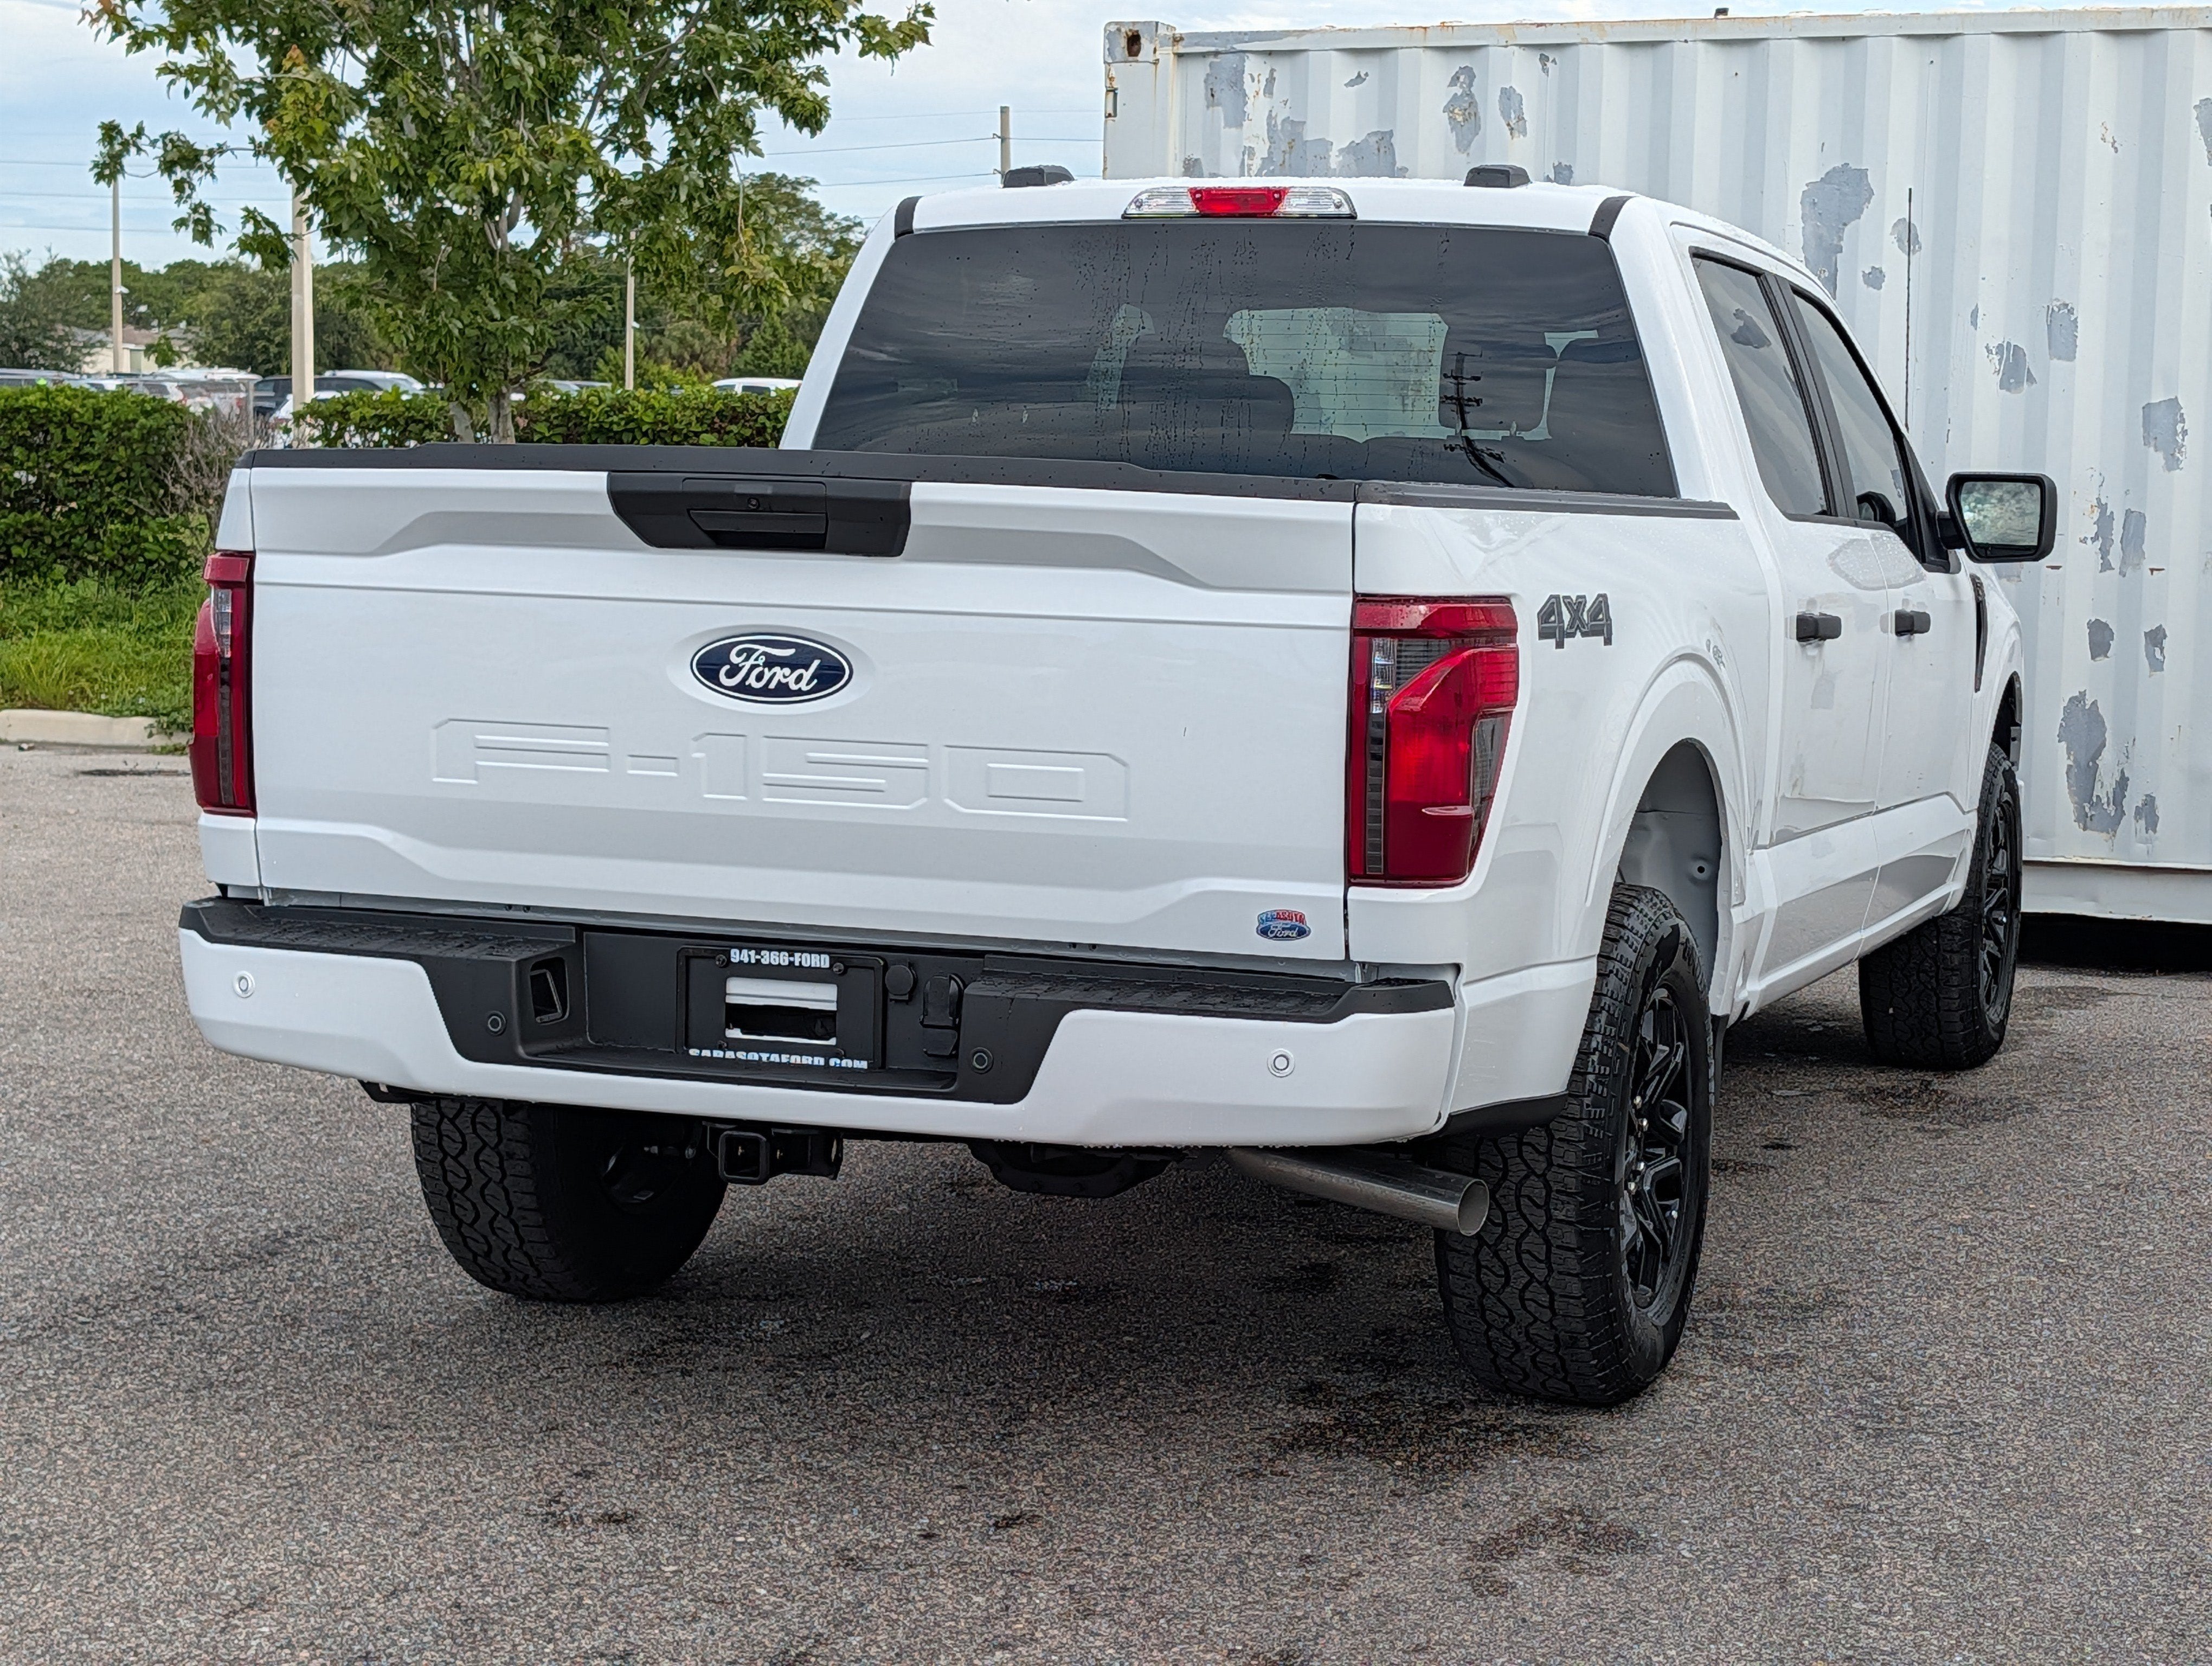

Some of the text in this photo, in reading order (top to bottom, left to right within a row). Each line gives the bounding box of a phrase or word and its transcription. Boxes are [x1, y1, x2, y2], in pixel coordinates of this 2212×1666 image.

[1536, 593, 1613, 650] 4X4
[719, 643, 821, 691] Ford
[432, 718, 1129, 822] F-150
[1268, 922, 1299, 938] Ford
[730, 949, 830, 969] 941-366-FORD
[688, 1048, 868, 1069] SARASOTAFORDCOM
